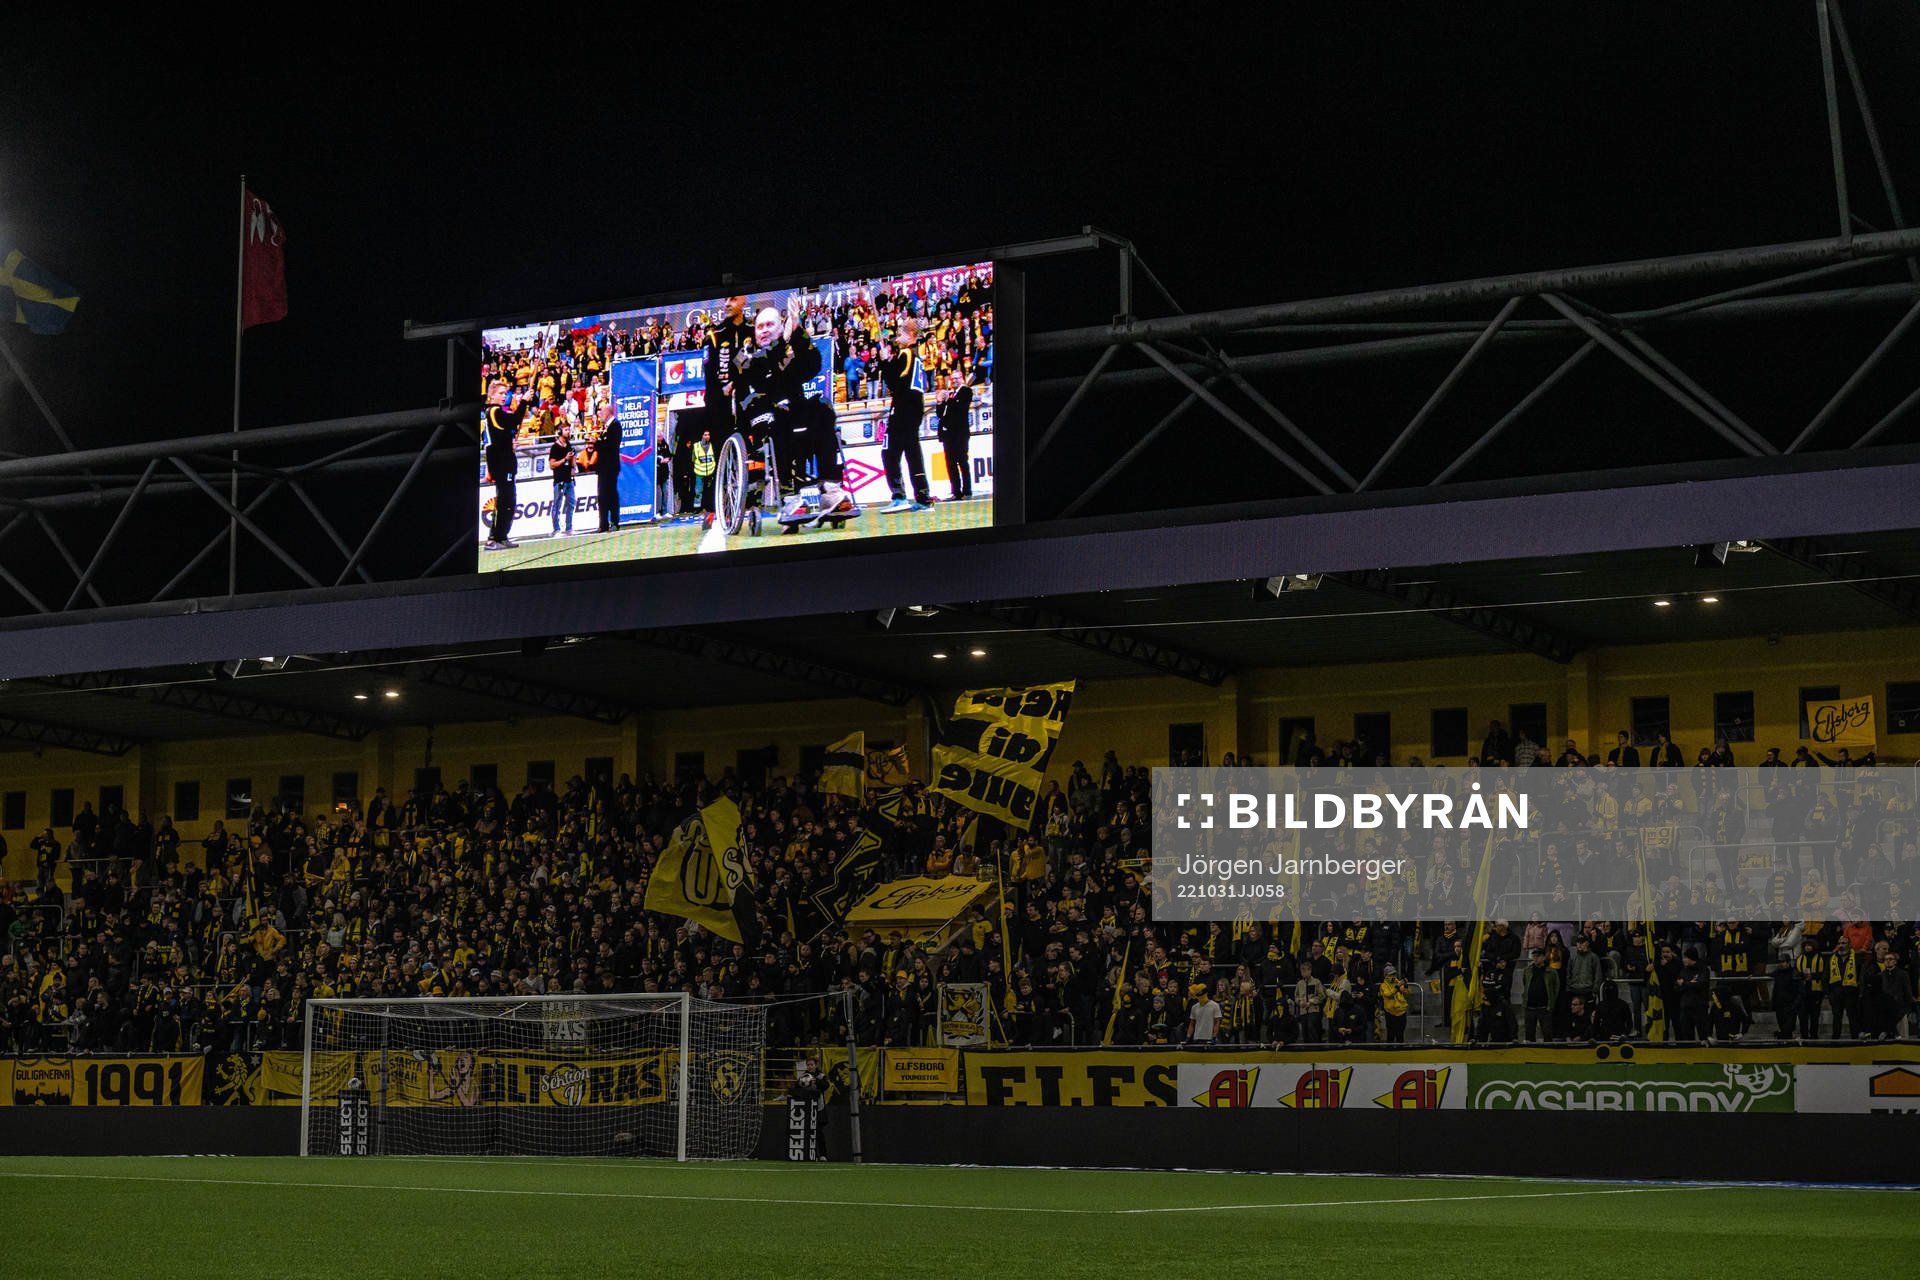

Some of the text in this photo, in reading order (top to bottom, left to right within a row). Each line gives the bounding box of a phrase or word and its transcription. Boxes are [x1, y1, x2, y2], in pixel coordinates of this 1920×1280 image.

[620, 418, 650, 429] OTBOLLS
[85, 1062, 182, 1105] 1991
[895, 1062, 945, 1071] ELFSBORG
[1486, 1090, 1744, 1112] CASHBUDDY
[340, 1099, 352, 1155] SELECT
[356, 1099, 368, 1155] SELECT
[789, 1100, 805, 1160] SELECT
[809, 1100, 817, 1160] SELECT
